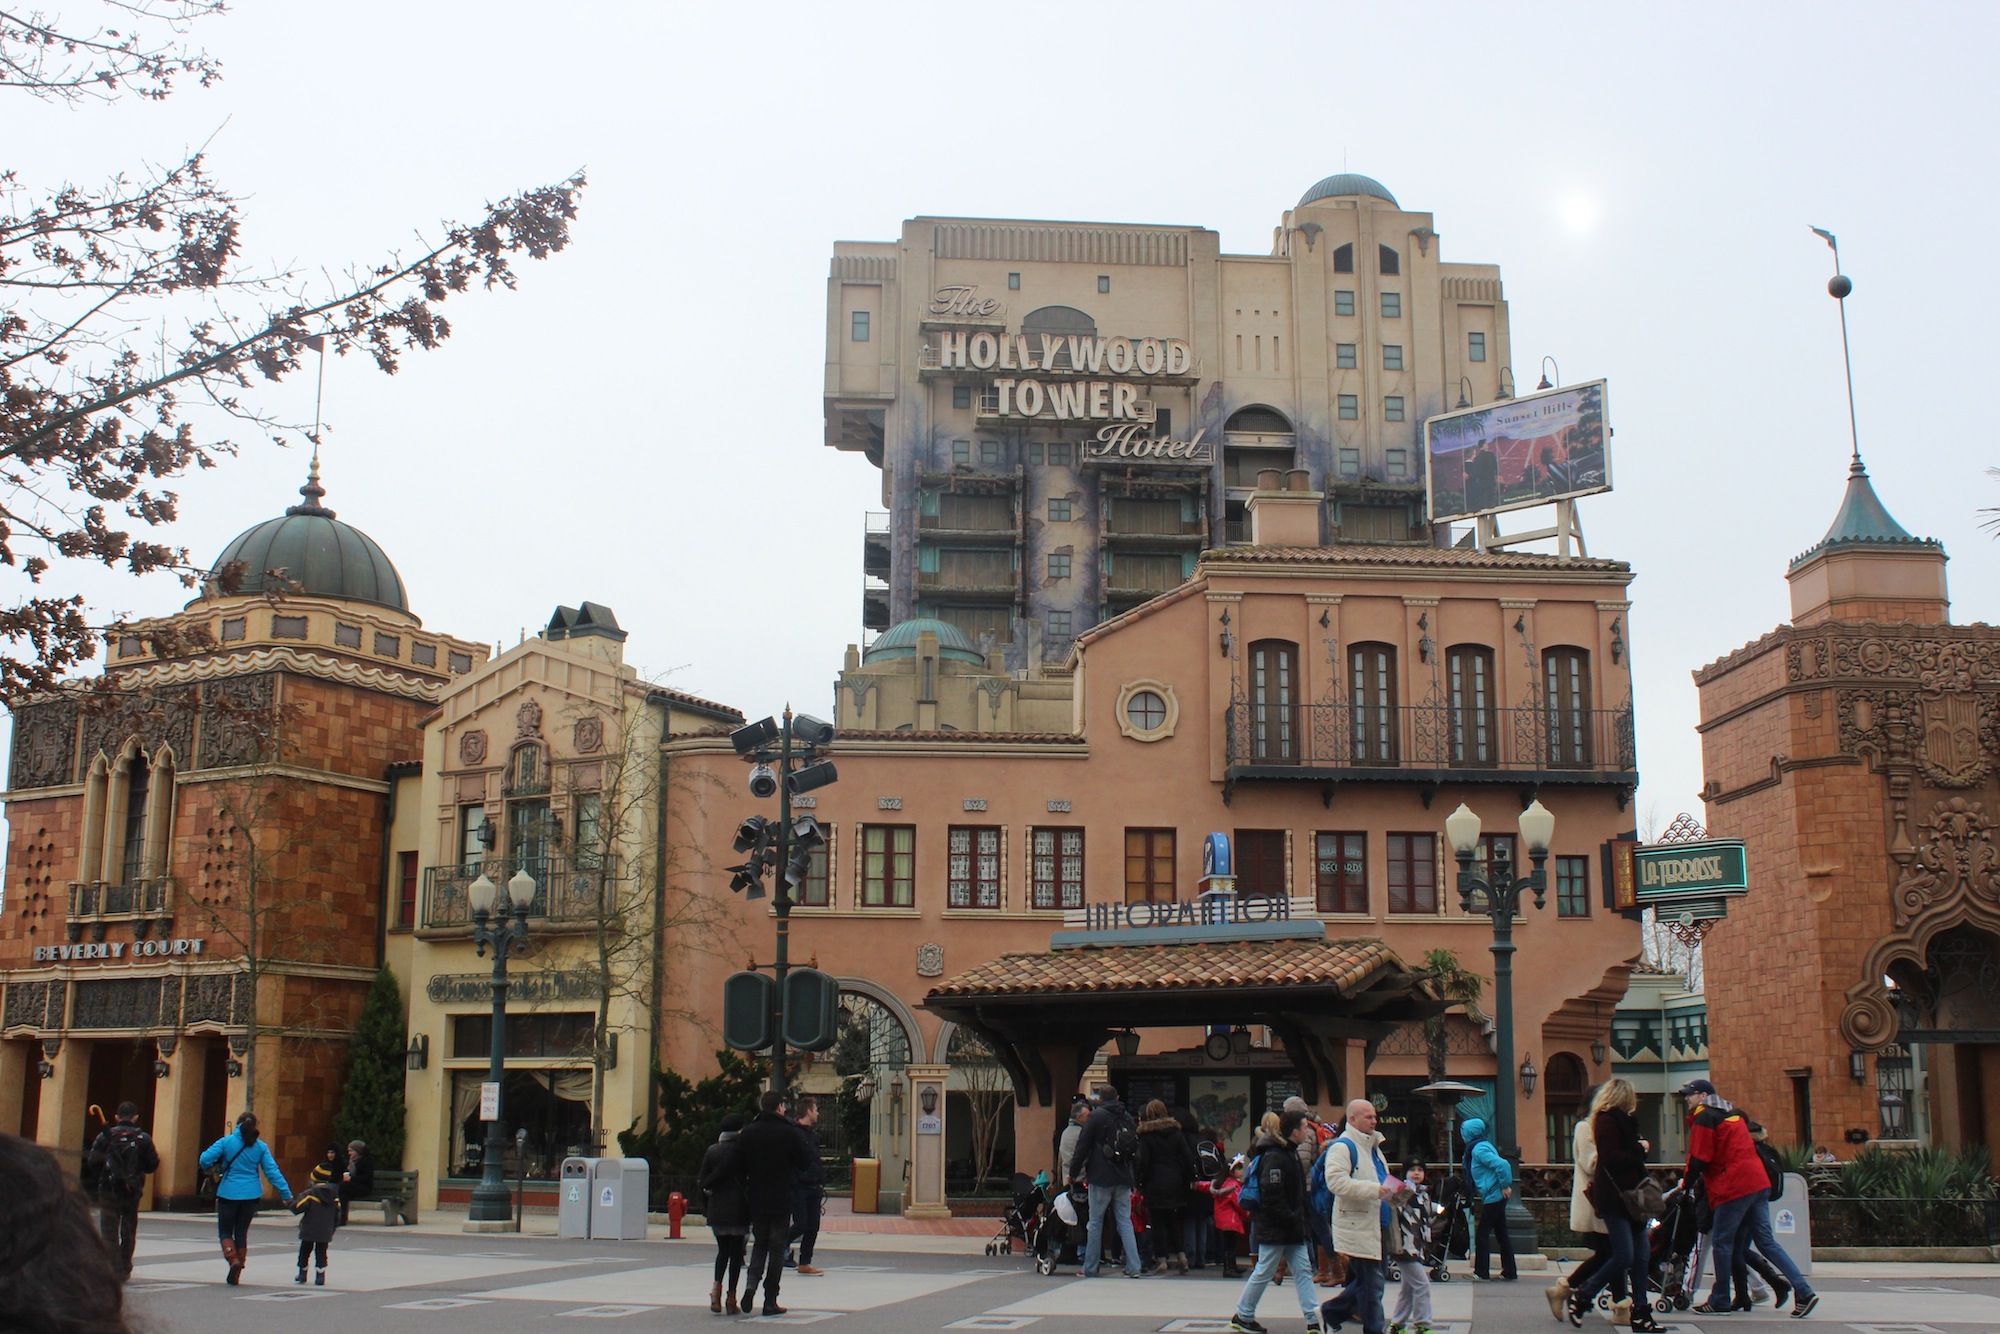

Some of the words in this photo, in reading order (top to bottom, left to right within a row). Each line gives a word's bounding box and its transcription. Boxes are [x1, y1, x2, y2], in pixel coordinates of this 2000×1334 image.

[929, 285, 1000, 316] The
[941, 331, 1192, 375] HOLLYWOOD
[994, 378, 1139, 420] TOWER
[1496, 410, 1538, 426] Sunset
[1543, 402, 1572, 416] Hills
[1091, 423, 1206, 460] Hotel
[1319, 847, 1363, 858] MULHLLAND
[1641, 859, 1660, 886] LA
[1658, 855, 1723, 887] TERRASSE
[1085, 892, 1290, 931] INFORMATION
[33, 942, 125, 961] BEVERLY
[131, 938, 204, 958] COURT
